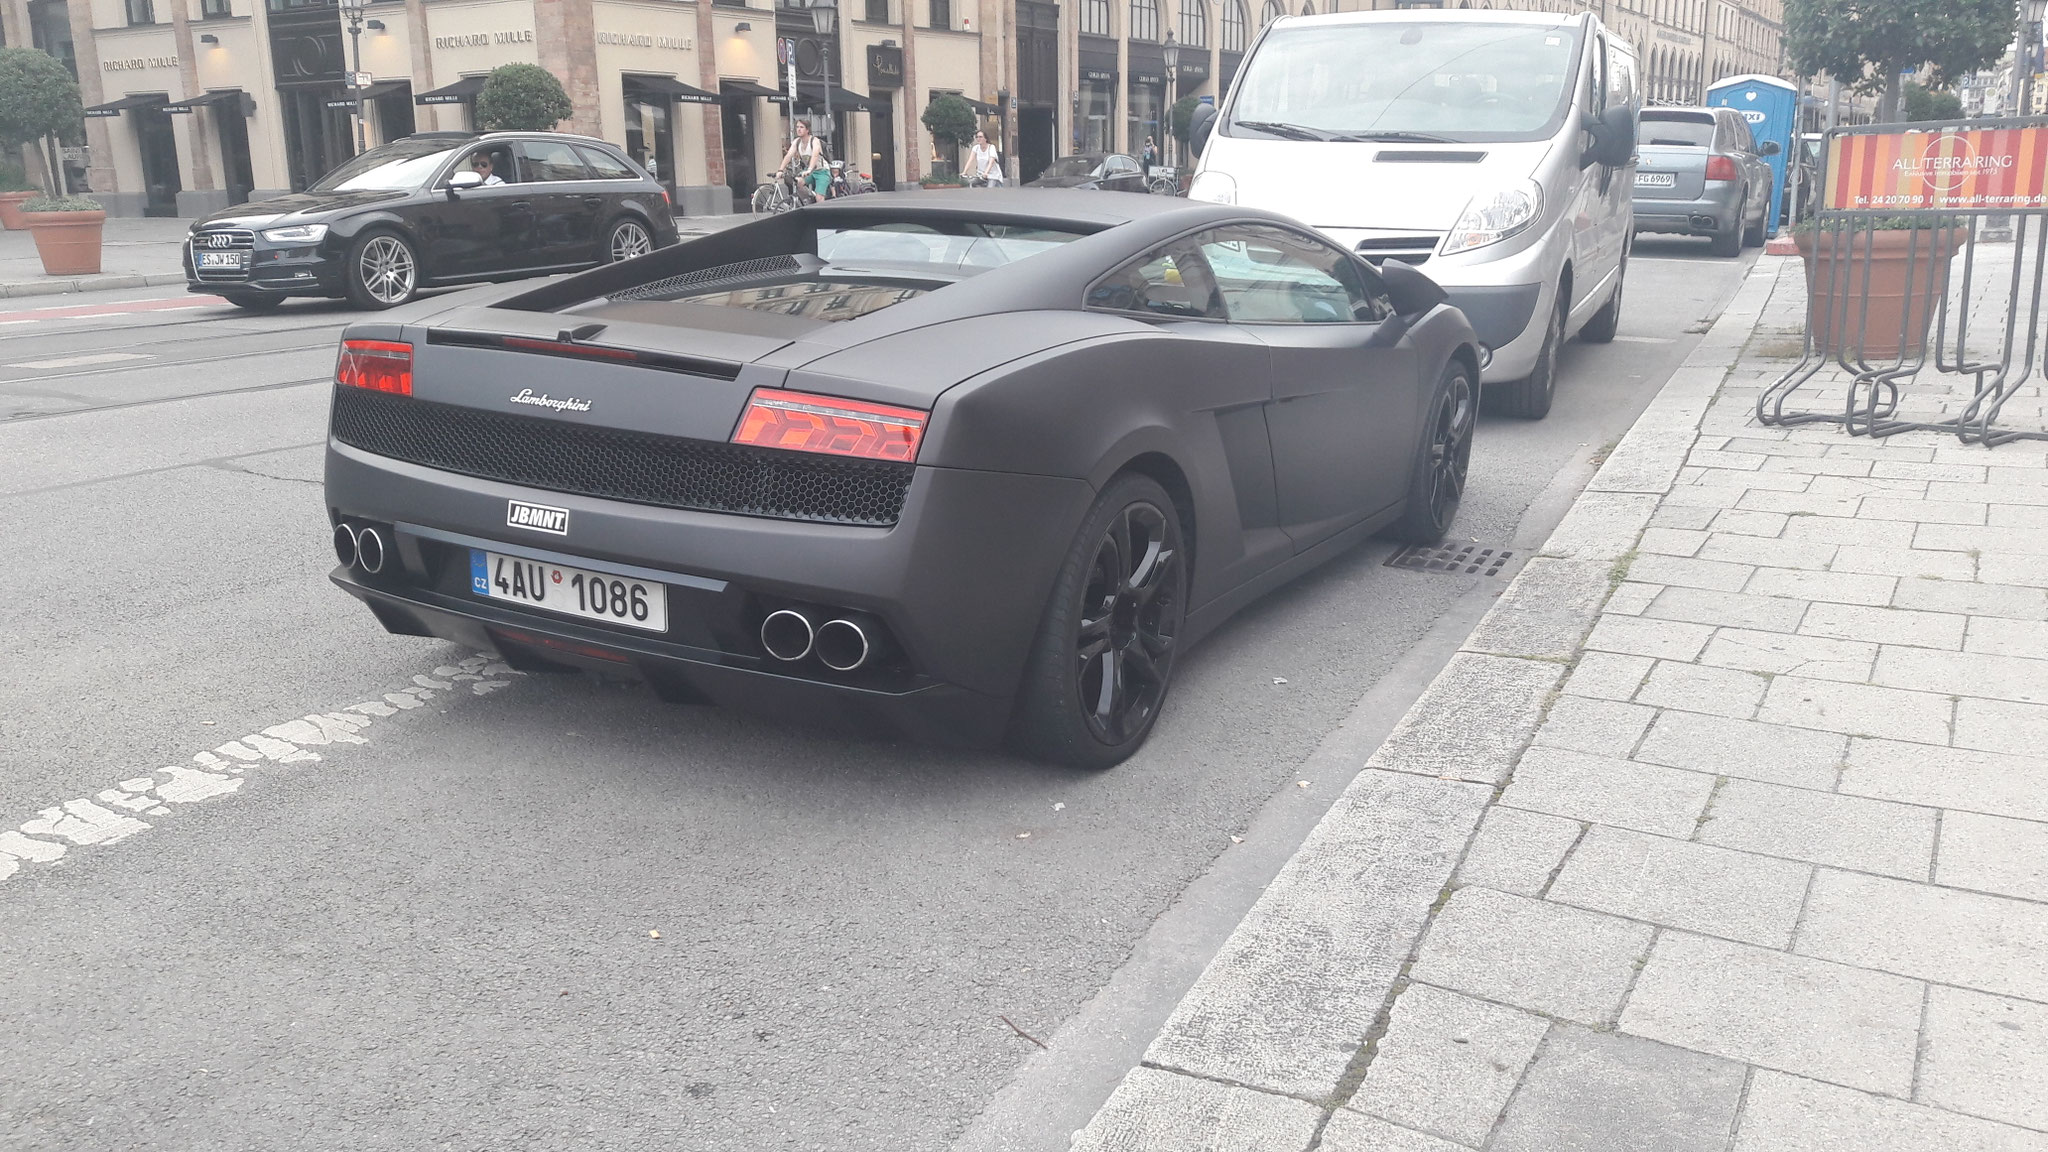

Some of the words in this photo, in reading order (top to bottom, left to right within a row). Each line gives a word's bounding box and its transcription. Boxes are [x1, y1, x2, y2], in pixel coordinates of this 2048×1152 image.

[436, 34, 489, 50] RICHARD
[494, 30, 532, 44] MILLE
[597, 31, 651, 48] RICHARD
[656, 36, 692, 51] MILLE
[103, 58, 145, 72] RICHARD
[149, 55, 179, 68] MILLE
[1650, 175, 1671, 183] 6969
[1854, 195, 1869, 204] Tel.
[1872, 195, 1884, 204] 24
[1884, 195, 1896, 204] 20
[1898, 195, 1911, 204] 70
[1911, 195, 1924, 204] 90
[1939, 193, 2047, 205] www.all-terraring.de
[226, 254, 240, 265] 150
[510, 388, 592, 412] Lamborghini
[474, 576, 487, 590] CZ
[494, 557, 546, 602] 4AU
[571, 573, 649, 622] 1086
